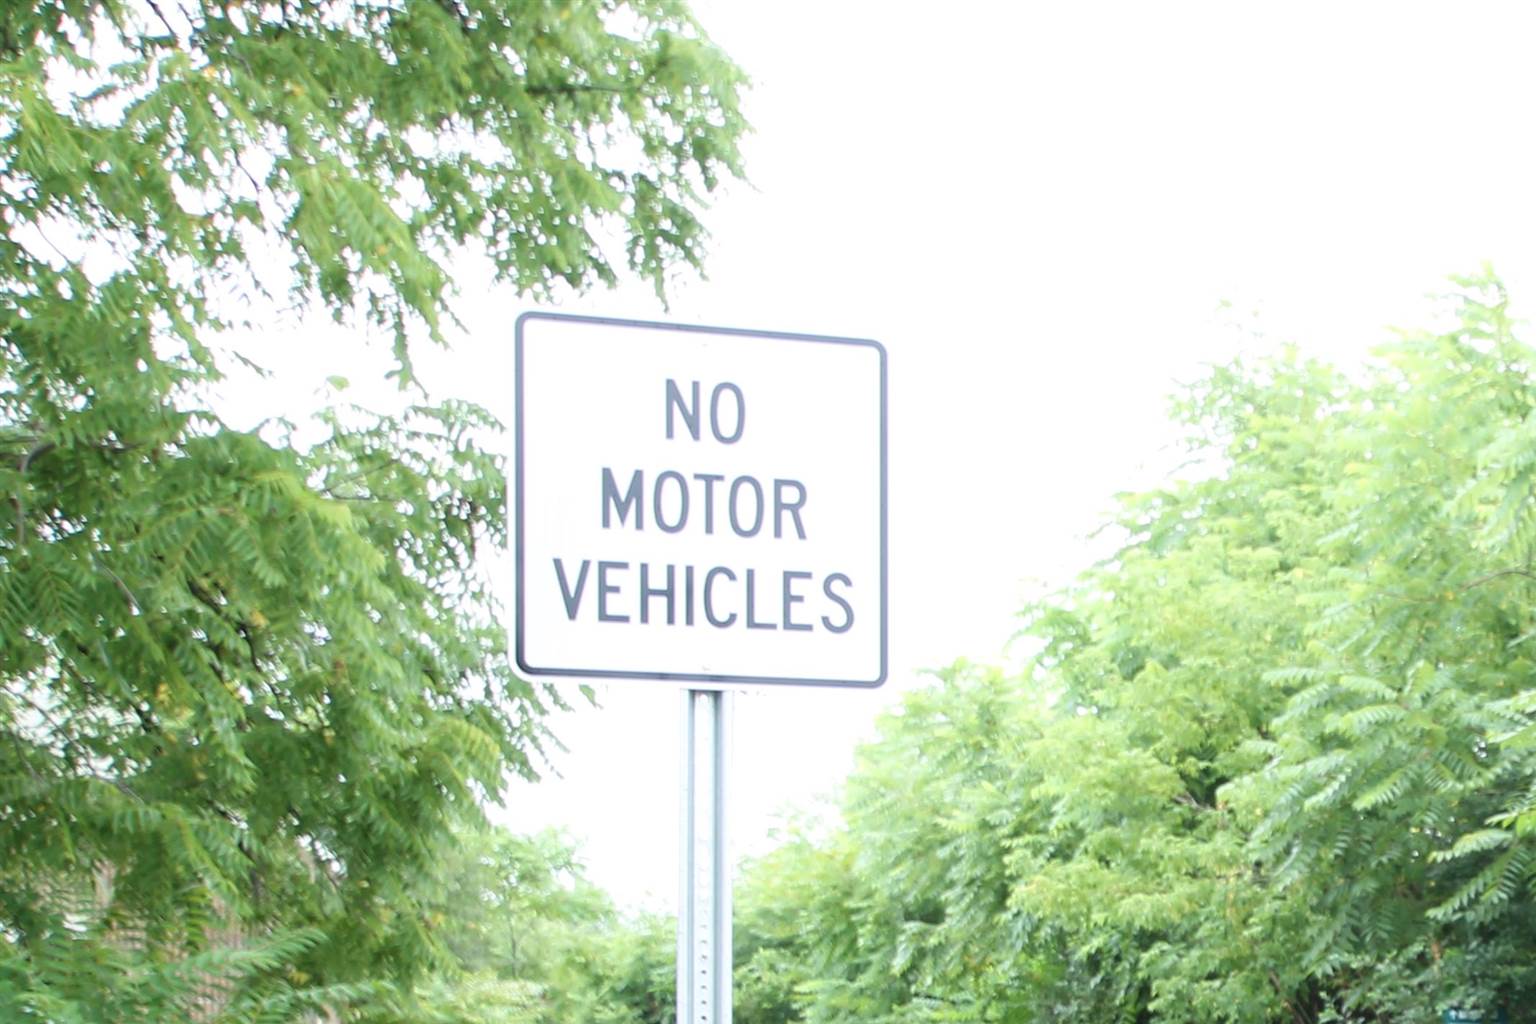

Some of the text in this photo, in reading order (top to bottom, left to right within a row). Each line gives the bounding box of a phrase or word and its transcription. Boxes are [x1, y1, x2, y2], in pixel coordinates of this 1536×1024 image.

[665, 378, 746, 446] NO
[601, 466, 808, 541] MOTOR
[552, 557, 855, 635] VEHICLES
